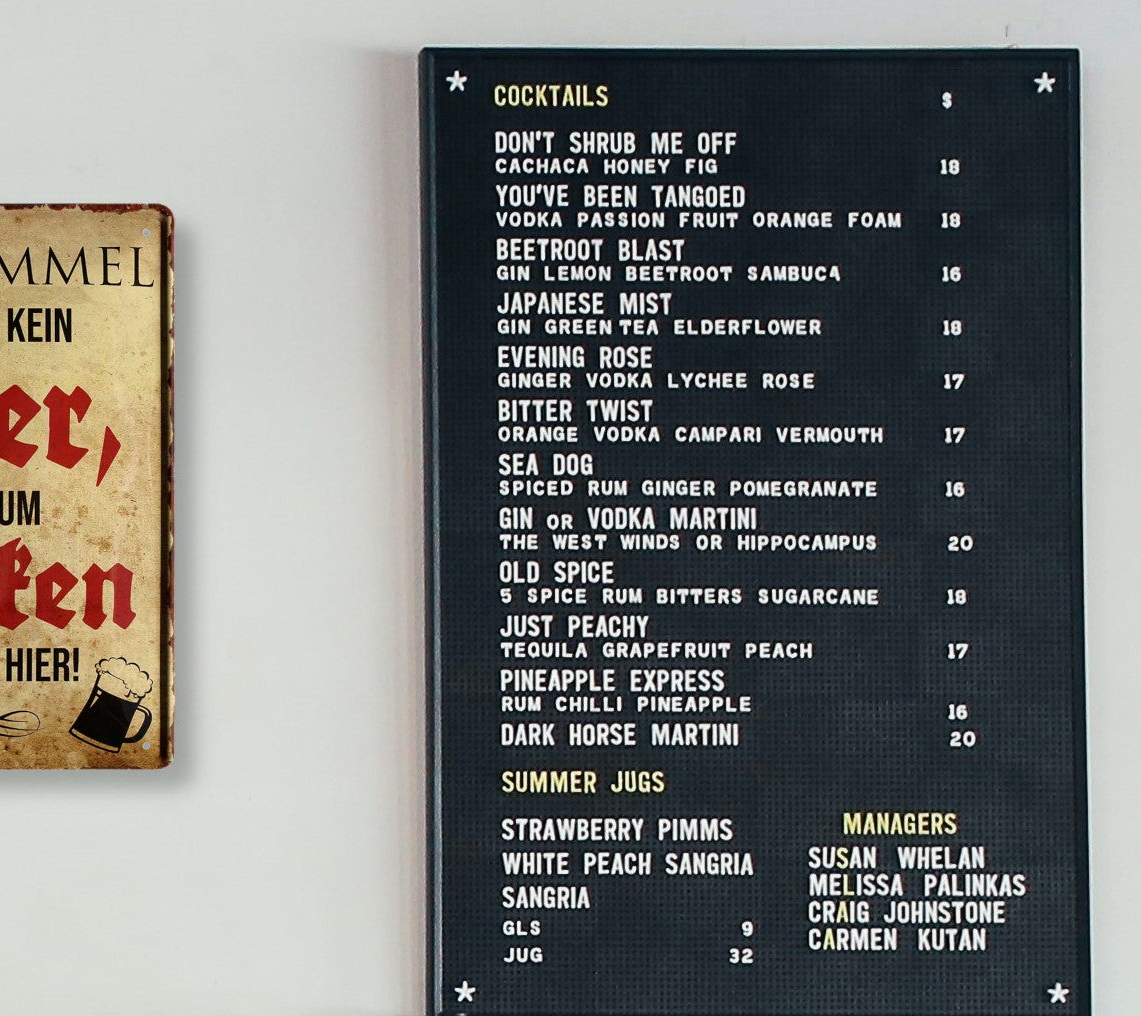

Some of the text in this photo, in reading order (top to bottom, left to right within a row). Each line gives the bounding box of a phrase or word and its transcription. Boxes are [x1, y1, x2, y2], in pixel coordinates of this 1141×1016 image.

[494, 84, 609, 107] COCKTAILS
[494, 130, 737, 155] DON'T SHRUB ME OFF
[495, 157, 960, 176] CACHACA HONEY FIG 18
[495, 183, 746, 209] YOU'VE BEEN TANGOED
[495, 211, 961, 229] VODKA PASSION FRUIT ORANGE FOAM 18
[496, 238, 685, 262] BEETROOT BLAST
[496, 265, 962, 283] GIN LEMON BEETROOT SAMBUCA 16
[496, 291, 672, 316] JAPANESE MIST
[8, 307, 73, 343] KEIN
[497, 318, 962, 336] GIN GREEN TEA ELDERFLOWER 18
[497, 345, 653, 370] EVENING ROSE
[497, 372, 965, 390] GINGER VODKA LYCHEE ROSE 17
[498, 399, 653, 423] BITTER TWIST
[497, 425, 966, 444] ORANGE VODKA CAMPARI VERMOUTH 17
[498, 453, 594, 476] SEA DOG
[499, 479, 965, 498] SPICED RUM GINGER POMEGRANATE 16
[499, 506, 757, 531] GIN OR VODKA MARTINI
[499, 533, 974, 552] THE WEST WINDS OR HIPPOCAMPUS 20
[499, 560, 615, 584] OLD SPICE
[499, 587, 967, 606] 5 SPICE RUM BITTERS SUGARCANE 18
[499, 614, 649, 639] JUST PEACHY
[500, 641, 969, 660] TEQUILA GRAPEFRUIT PEACH 17
[5, 647, 81, 682] HIER!
[500, 668, 725, 693] PINEAPPLE EXPRESS
[501, 695, 752, 713] RUM CHILLI PINEAPPLE
[947, 703, 968, 721] 16
[501, 722, 739, 747] DARK HORSE MARTINI
[949, 730, 977, 748] 20
[501, 770, 665, 794] SUMMER JUGS
[501, 817, 734, 842] STRAWBERRY PIMMS
[843, 812, 958, 836] MANAGERS
[502, 851, 754, 876] WHITE PEACH SANGRIA
[808, 845, 985, 870] SUSAN WHELAN
[502, 885, 591, 910] SANGRIA
[809, 873, 1027, 898] MELISSA PALINKAS
[808, 900, 1006, 925] CRAIG JOHNSTONE
[502, 920, 754, 937] GLS 9
[808, 927, 987, 952] CARMEN KUTAN
[503, 946, 754, 964] JUG 32
